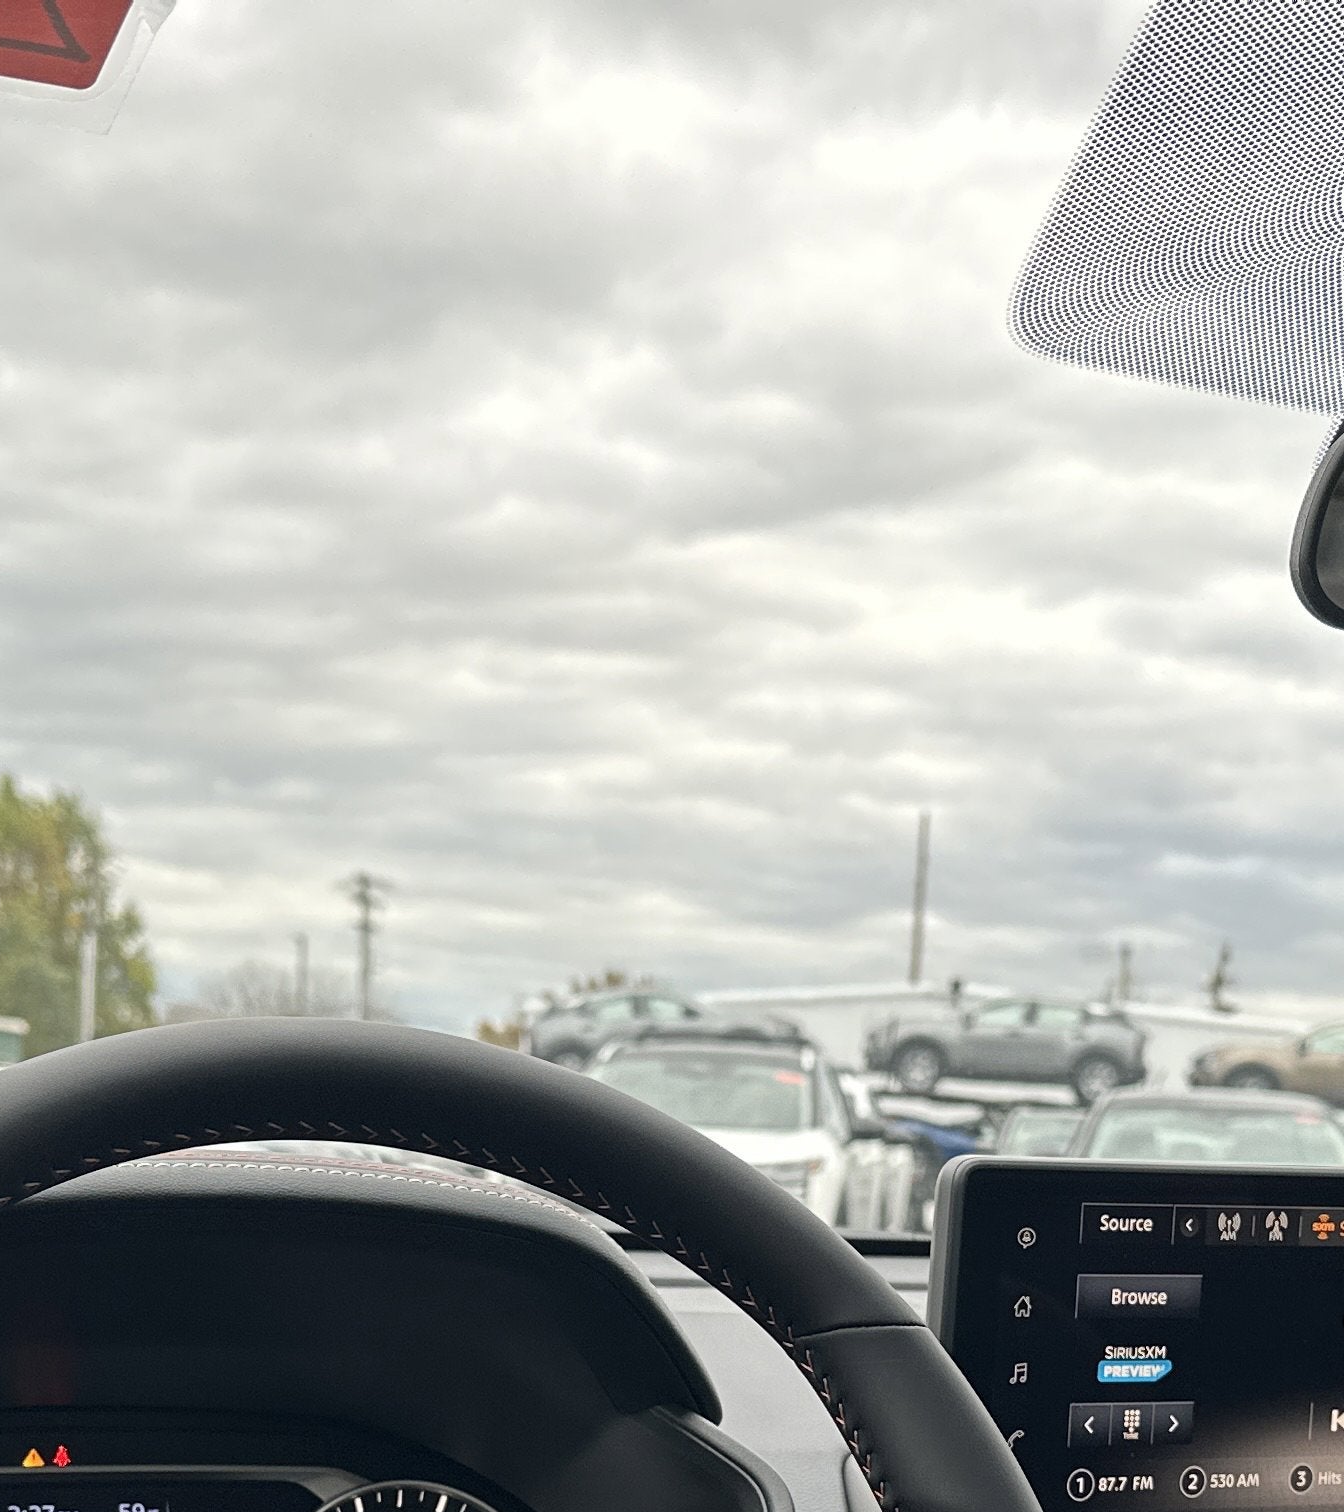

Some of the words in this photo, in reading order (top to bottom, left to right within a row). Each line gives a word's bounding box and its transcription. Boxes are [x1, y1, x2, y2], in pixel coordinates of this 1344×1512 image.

[1099, 1215, 1154, 1232] Source
[1219, 1230, 1238, 1242] AM
[1110, 1287, 1168, 1306] Browse
[1104, 1345, 1167, 1360] SIRIUSXM
[1103, 1364, 1166, 1378] PREVIEW
[1075, 1476, 1085, 1494] 1
[1097, 1476, 1128, 1492] 87.7
[1132, 1475, 1154, 1491] FM
[1187, 1472, 1200, 1491] 2
[1209, 1473, 1234, 1489] 530
[1236, 1472, 1260, 1488] AM
[1296, 1470, 1307, 1487] 3
[1317, 1470, 1343, 1486] Hits
